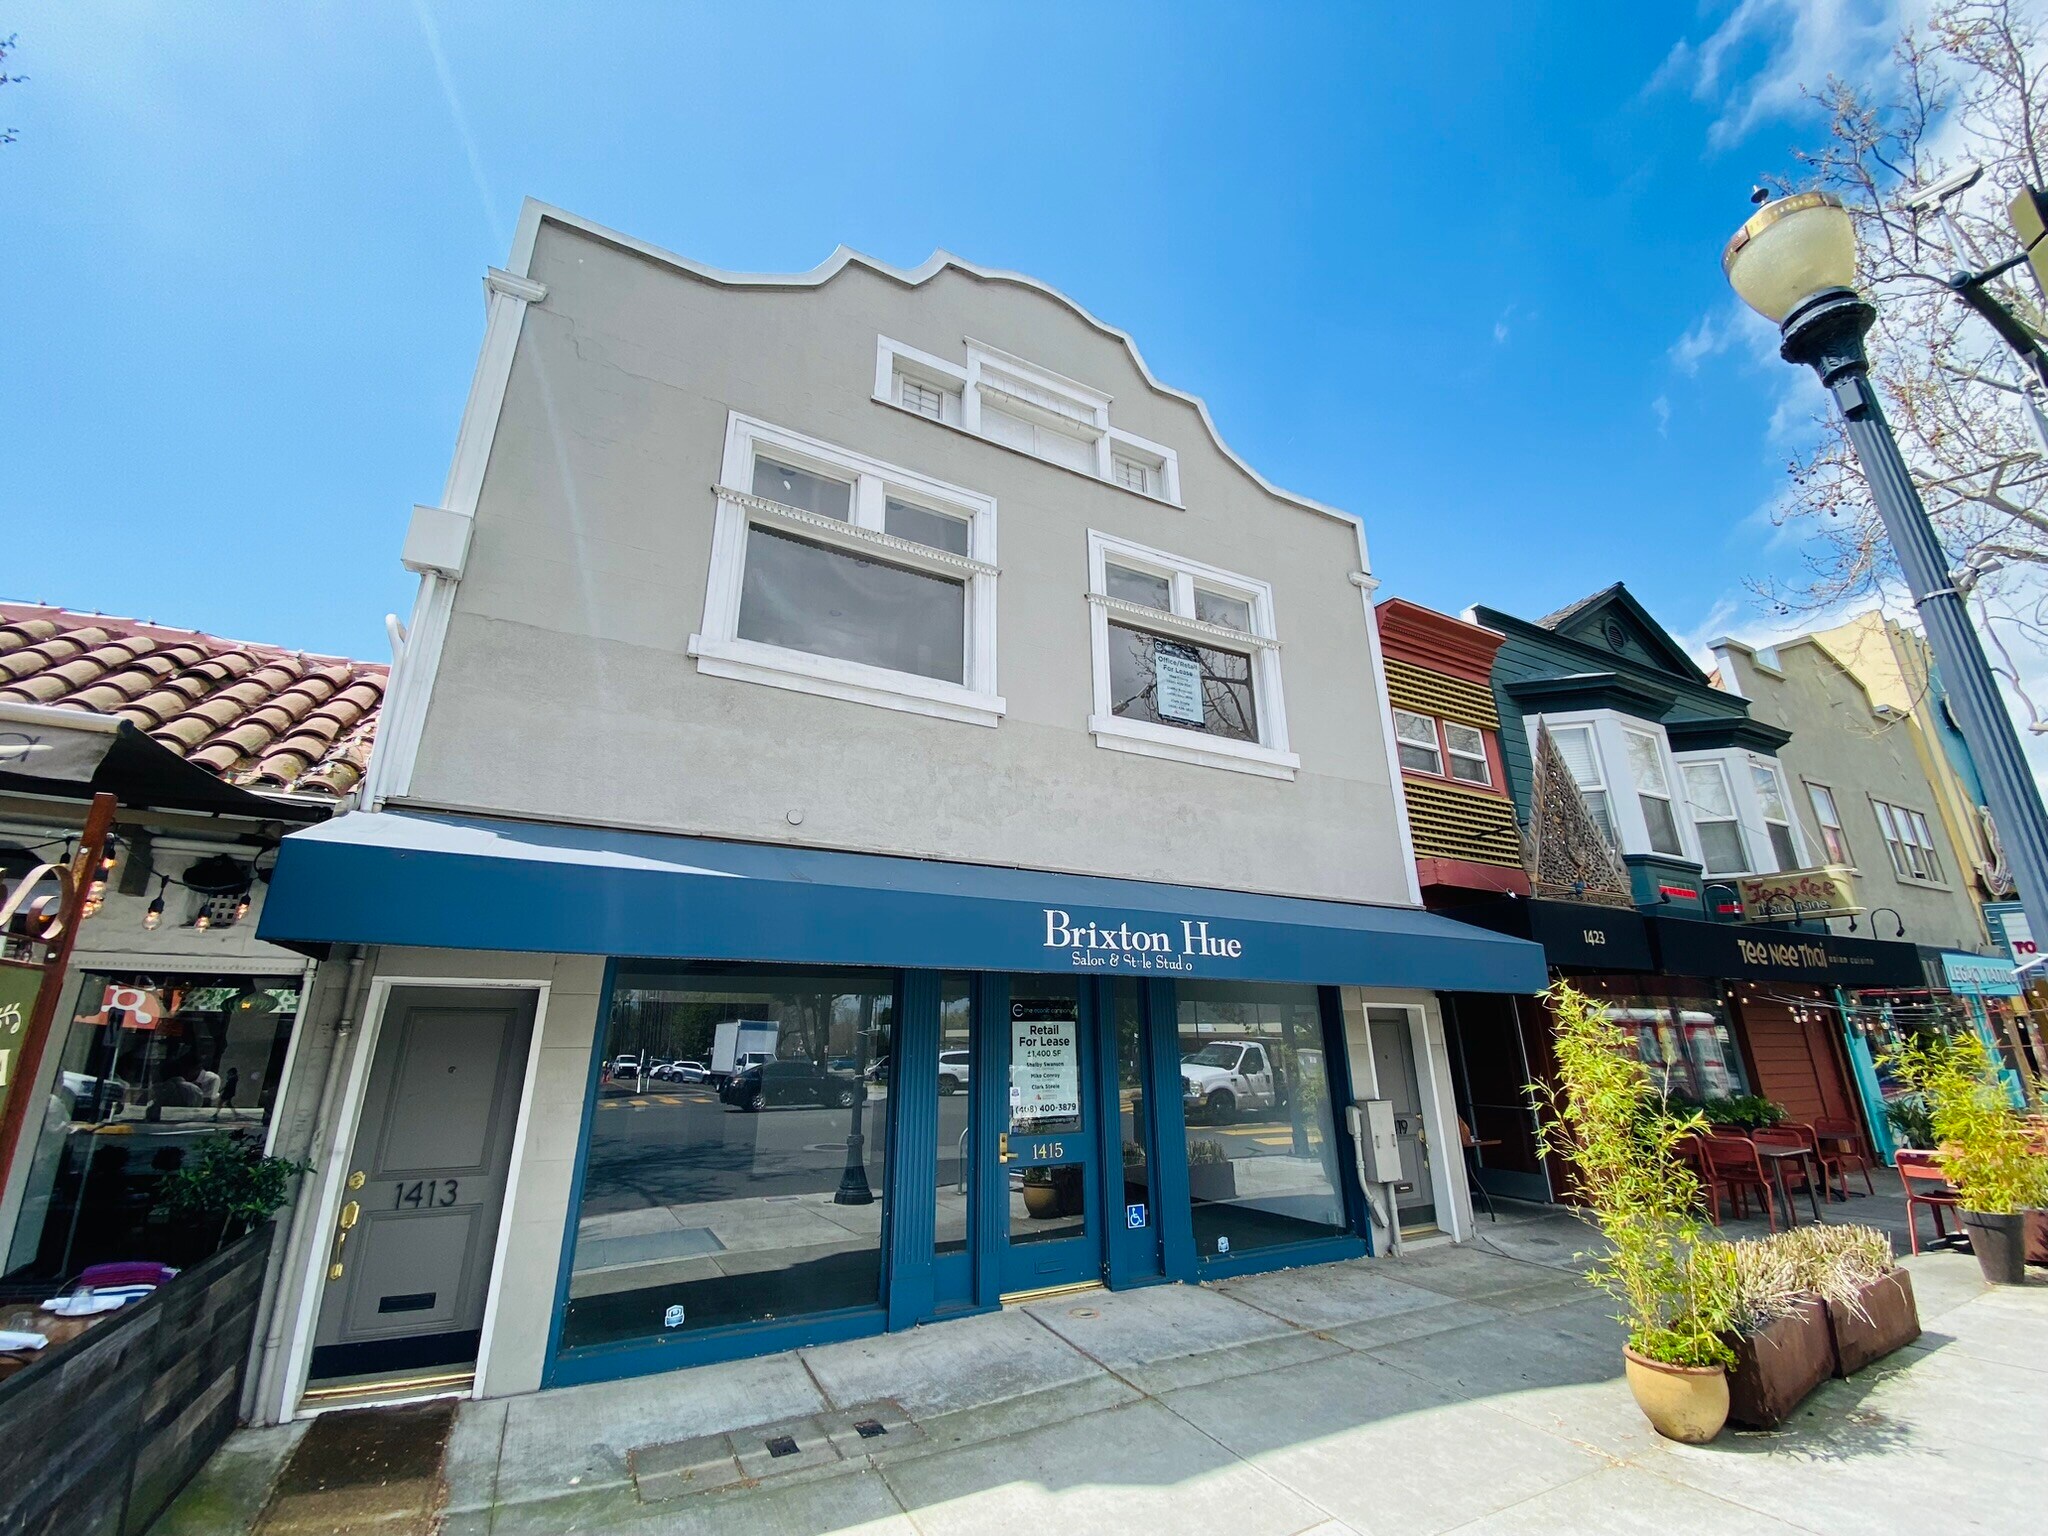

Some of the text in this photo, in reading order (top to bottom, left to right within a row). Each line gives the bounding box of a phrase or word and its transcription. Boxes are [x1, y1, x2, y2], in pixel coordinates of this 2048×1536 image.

[1175, 667, 1193, 677] Lease
[1043, 909, 1242, 958] Brixton Hue
[1583, 930, 1605, 946] 1423
[1072, 950, 1106, 966] Salon
[1110, 953, 1119, 967] &
[1123, 953, 1152, 969] Stle
[1737, 939, 1768, 965] Tee
[1768, 943, 1800, 967] Nee
[1798, 942, 1828, 968] Thai
[1030, 1025, 1059, 1035] Retail
[1019, 1037, 1070, 1047] For Lease
[1039, 1102, 1077, 1112] 400-3879
[1032, 1142, 1064, 1159] 1415
[396, 1179, 458, 1210] 1413
